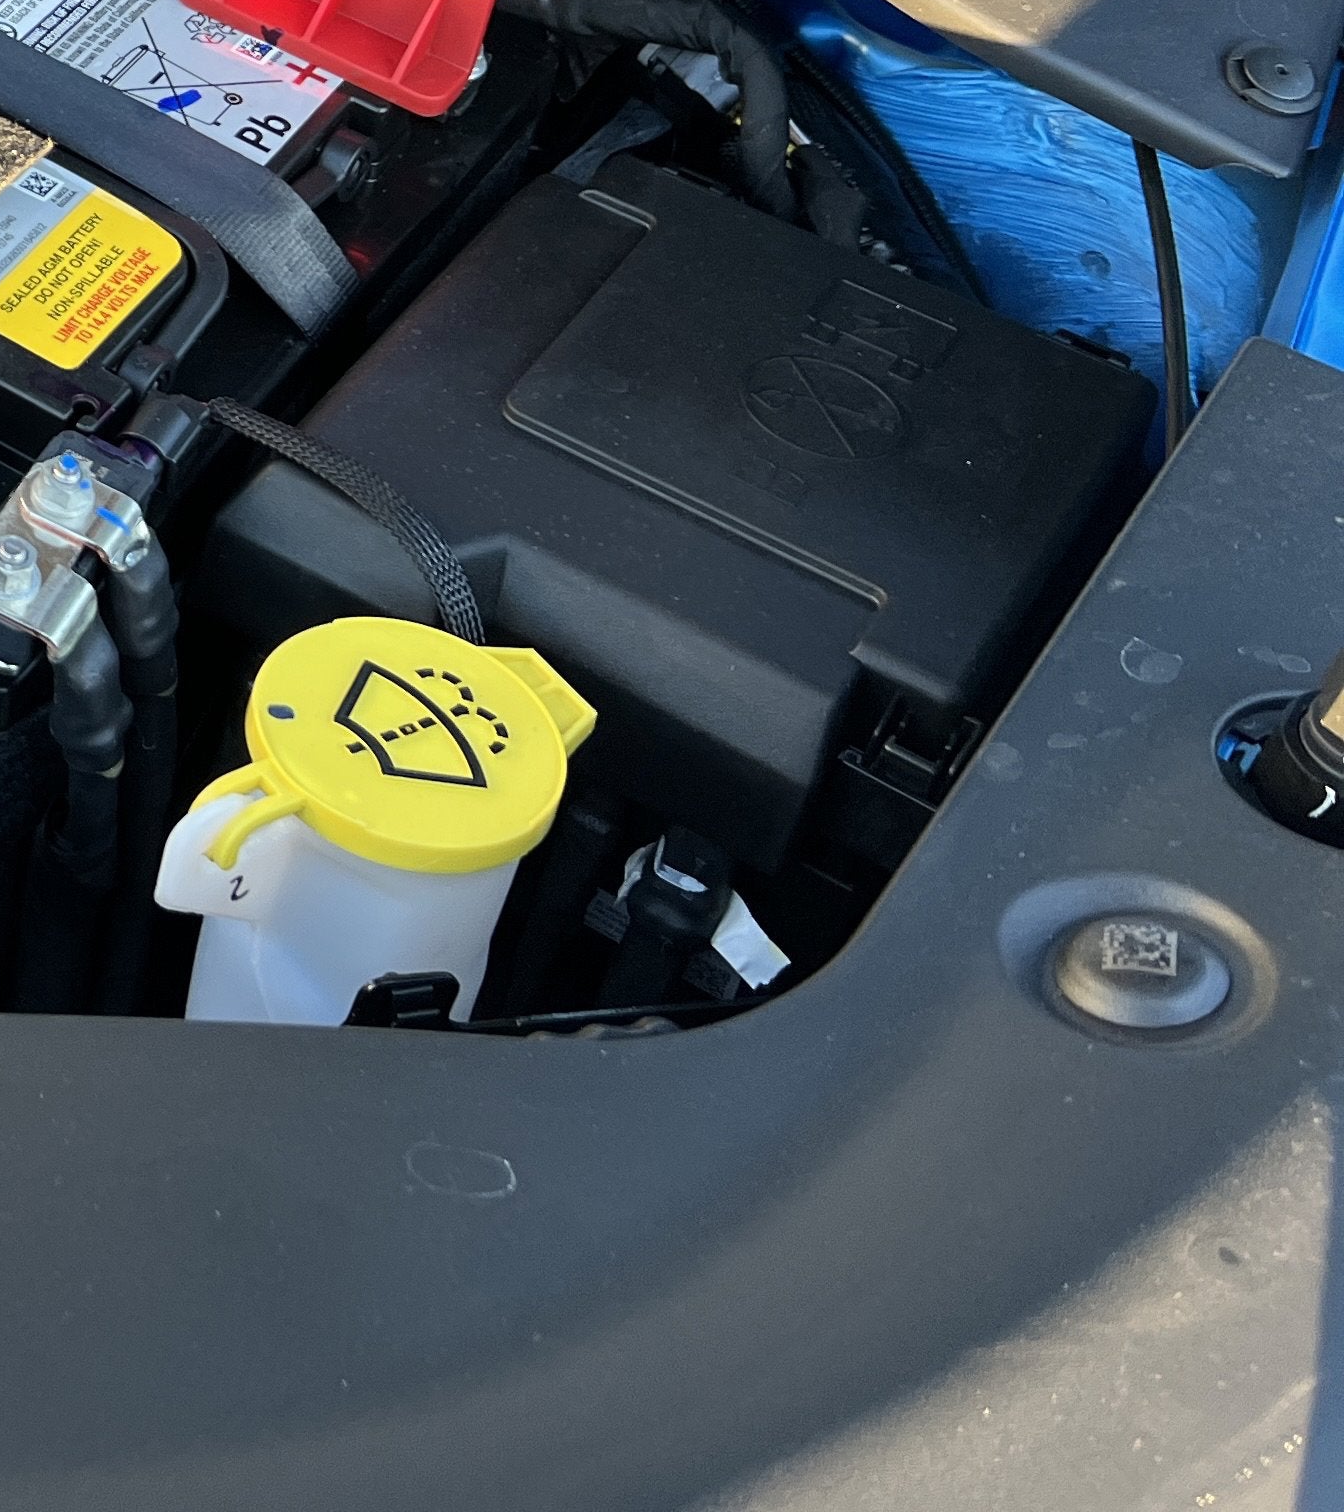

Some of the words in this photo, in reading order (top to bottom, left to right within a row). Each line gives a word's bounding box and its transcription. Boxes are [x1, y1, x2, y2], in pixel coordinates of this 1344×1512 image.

[234, 114, 292, 154] Pb
[0, 274, 41, 313] SEALED
[36, 252, 63, 276] AGM
[58, 213, 103, 254] BATTERY
[34, 287, 53, 303] DO
[48, 267, 73, 288] NOT
[68, 237, 102, 268] OPEN!
[47, 245, 123, 320] NON-SPILLABLE
[53, 316, 82, 342] LIMIT
[76, 283, 114, 319] CHARGE
[108, 246, 150, 286] VOLTAGE
[75, 329, 92, 344] TO
[87, 310, 111, 331] 14.4
[106, 284, 137, 313] VOLTS
[132, 261, 159, 285] MAX.
